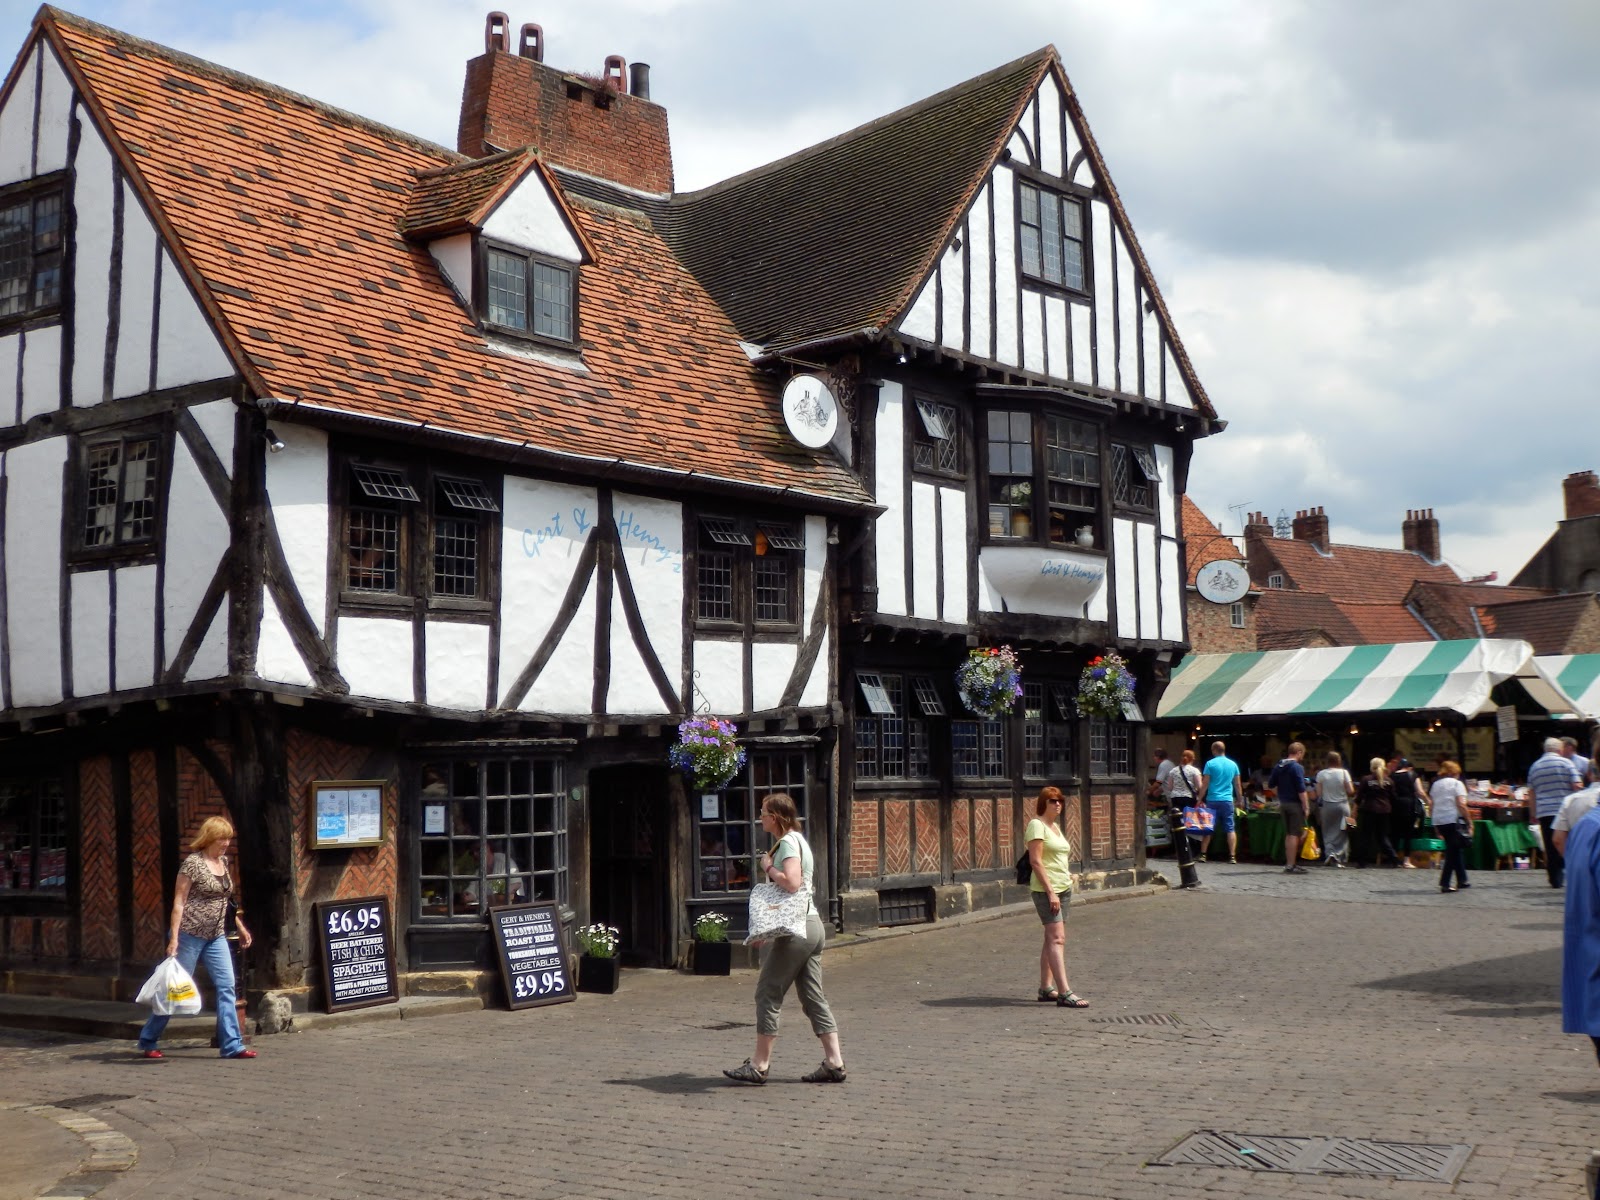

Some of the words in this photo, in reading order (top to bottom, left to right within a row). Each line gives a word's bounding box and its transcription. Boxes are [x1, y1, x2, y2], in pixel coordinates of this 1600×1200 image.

[522, 512, 565, 558] Gert
[573, 508, 591, 535] &
[1041, 560, 1062, 577] Gert
[328, 907, 381, 934] £6.95
[500, 915, 518, 924] GERT
[524, 912, 551, 921] HENRY'S
[503, 924, 554, 937] TRADITIONAL
[330, 941, 348, 950] BEER
[349, 937, 383, 947] BATTERED
[505, 936, 533, 947] ROAST
[534, 934, 555, 943] BEEF
[331, 948, 352, 961] FISH
[353, 947, 359, 958] &
[360, 944, 385, 957] CHIPS
[333, 961, 386, 978] SPAGHETTI
[510, 957, 560, 971] VEGETABLES
[348, 987, 364, 996] ROAST
[364, 984, 388, 993] POTATOES
[515, 970, 565, 998] £9.95
